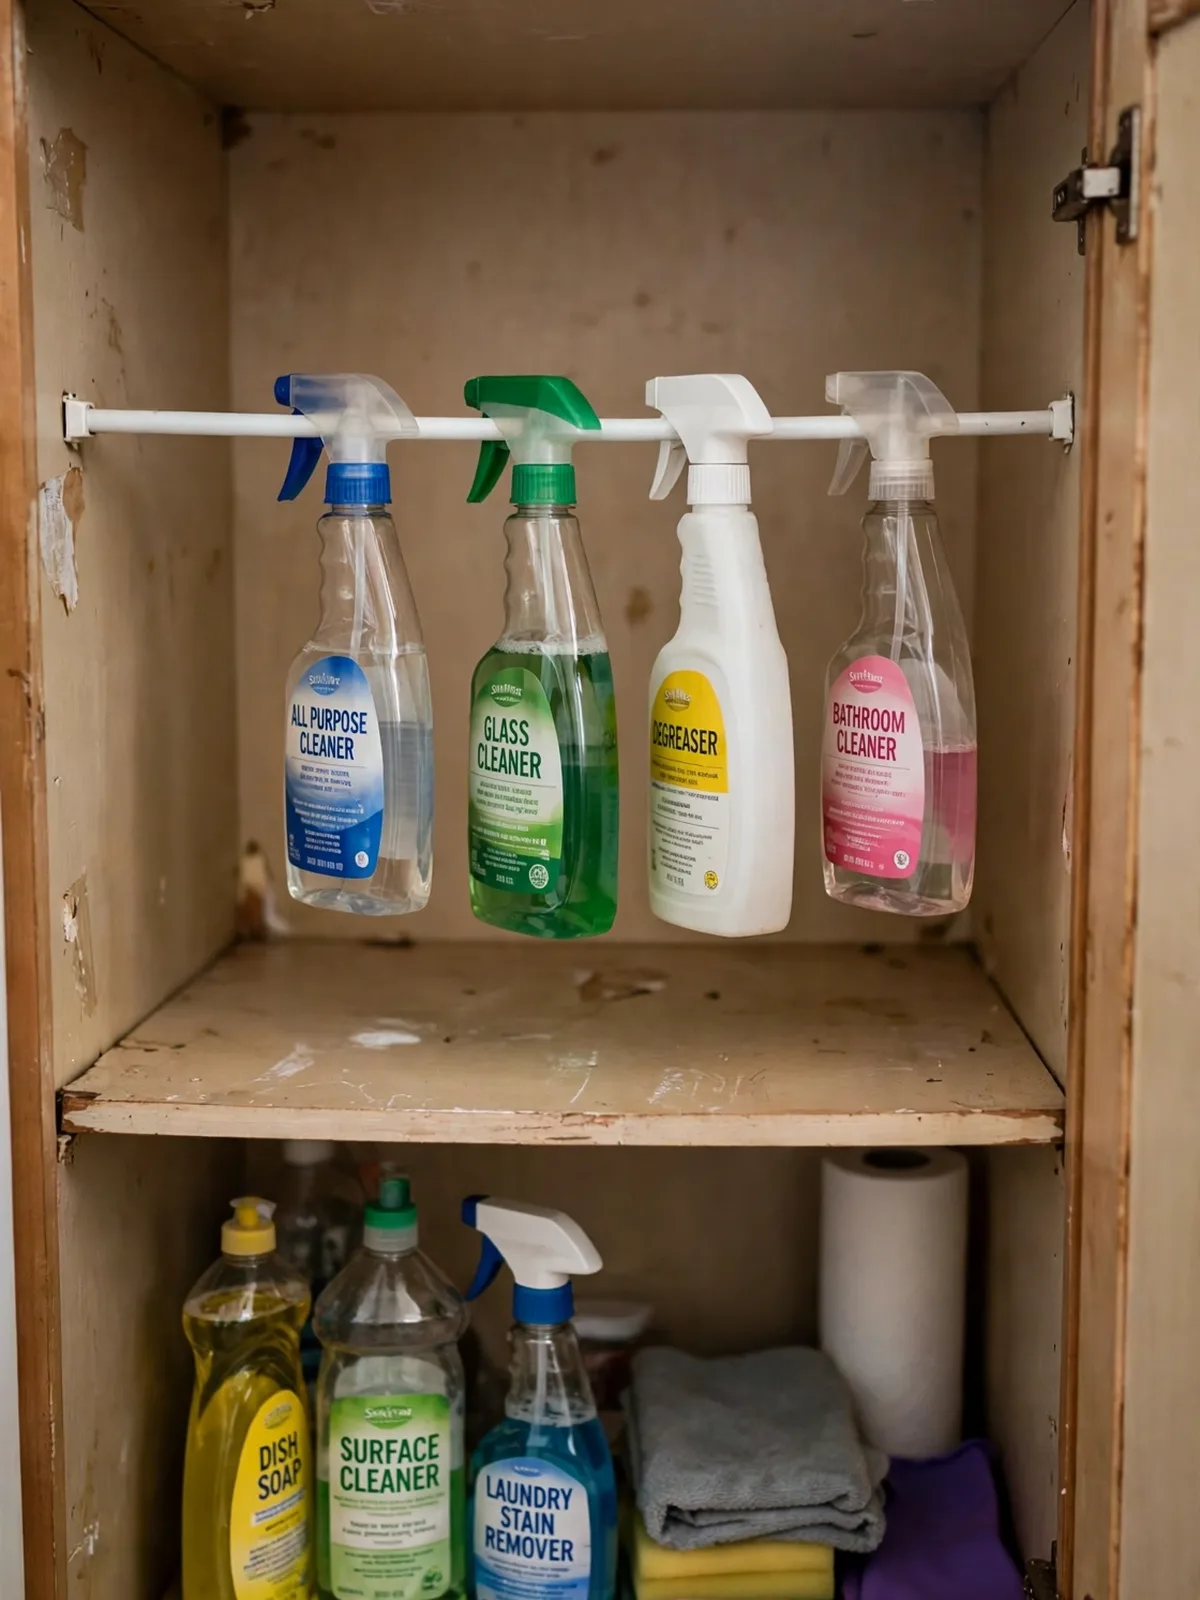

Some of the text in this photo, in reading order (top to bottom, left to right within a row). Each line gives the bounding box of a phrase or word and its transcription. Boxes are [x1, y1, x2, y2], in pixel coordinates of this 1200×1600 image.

[291, 704, 367, 735] ALL PURPOSE
[484, 715, 529, 746] GLASS
[833, 702, 905, 734] BATHROOM
[300, 732, 354, 760] CLEANER
[653, 720, 718, 756] DEGREASER
[837, 729, 897, 762] CLEANER
[477, 743, 542, 779] CLEANER
[260, 1431, 298, 1471] DISH
[340, 1433, 439, 1464] SURFACE
[258, 1458, 302, 1500] SOAP
[340, 1464, 439, 1494] CLEANER
[486, 1475, 573, 1510] LAUNDRY
[501, 1506, 555, 1535] STAIN
[485, 1525, 574, 1561] REMOVER
